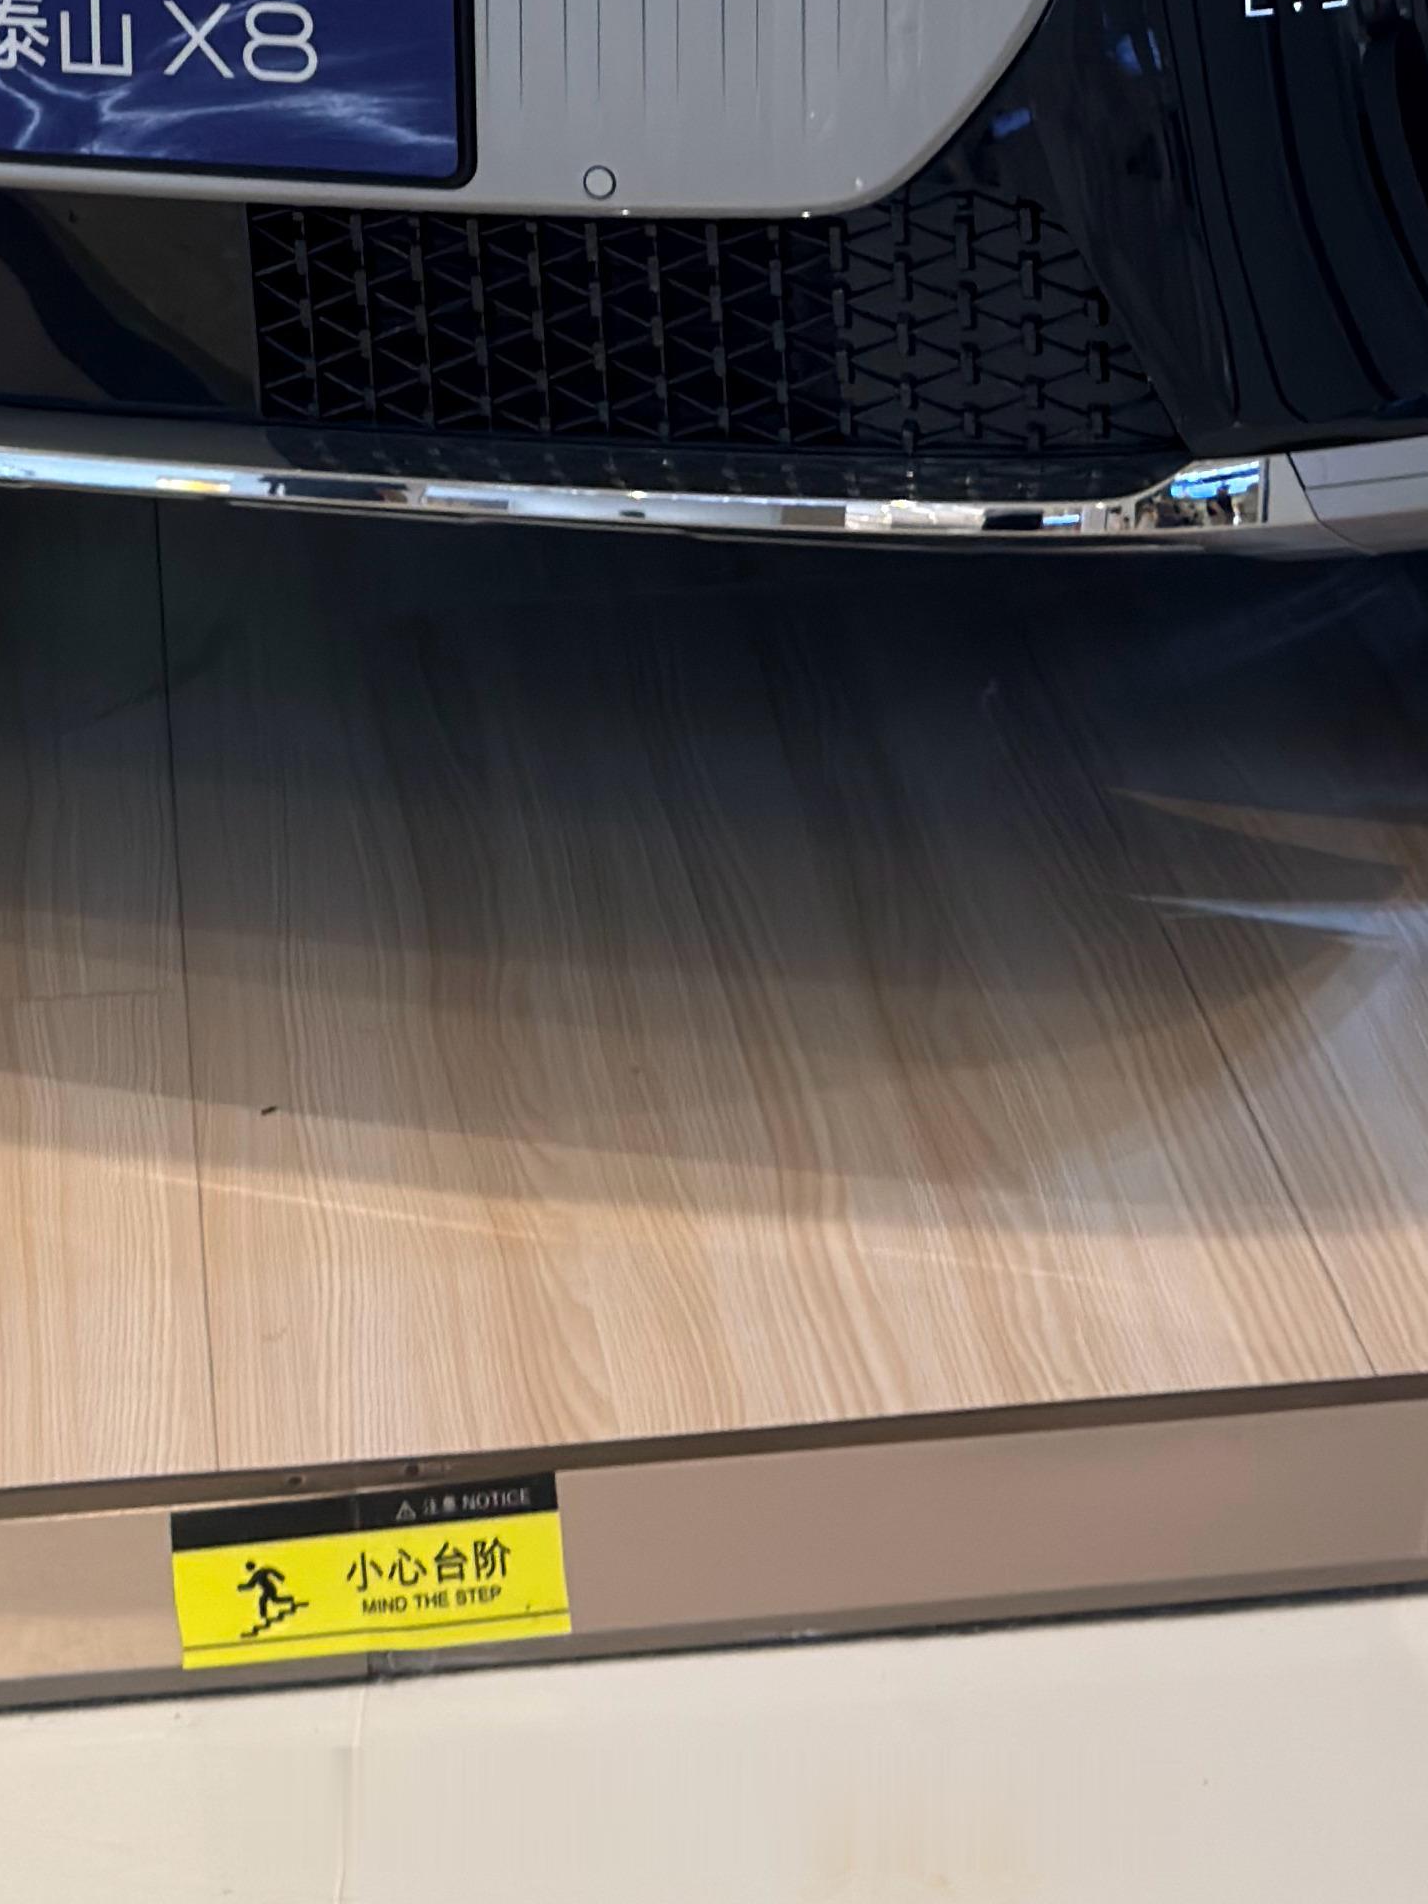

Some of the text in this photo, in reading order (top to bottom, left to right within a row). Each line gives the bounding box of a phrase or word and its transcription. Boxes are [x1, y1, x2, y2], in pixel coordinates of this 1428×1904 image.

[461, 1486, 531, 1511] NOTICE
[346, 1536, 511, 1593] 小心台阶
[361, 1584, 502, 1616] MIND THE STEP
